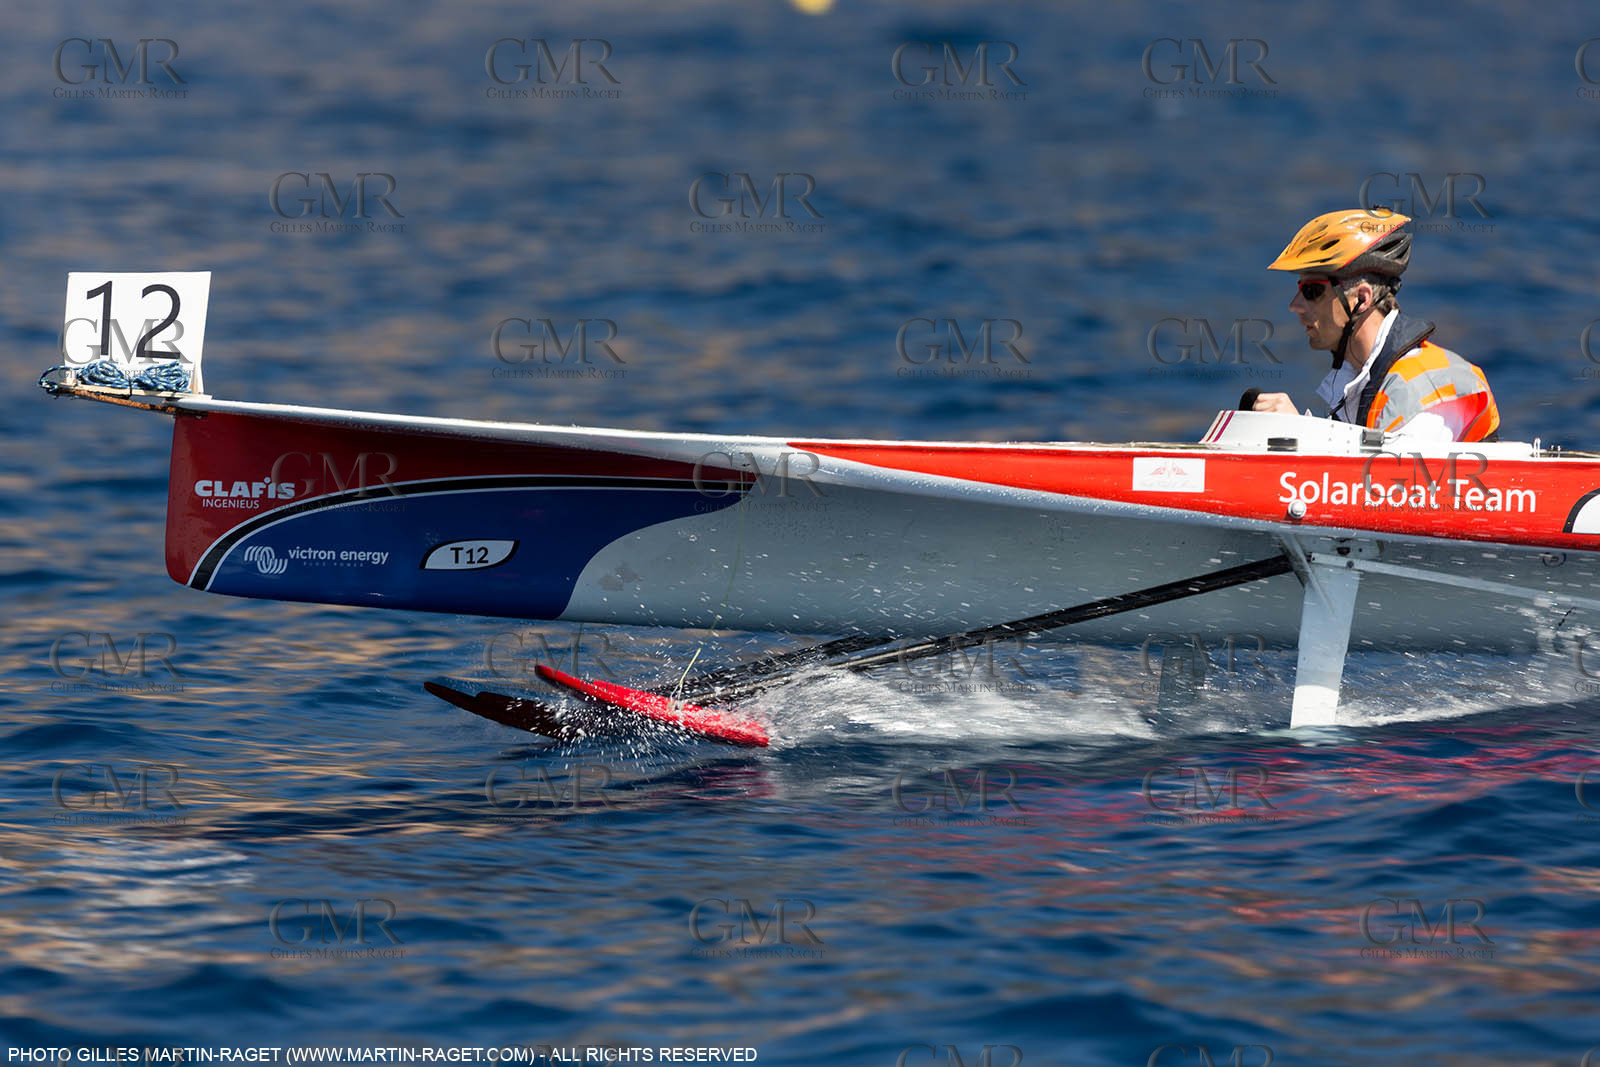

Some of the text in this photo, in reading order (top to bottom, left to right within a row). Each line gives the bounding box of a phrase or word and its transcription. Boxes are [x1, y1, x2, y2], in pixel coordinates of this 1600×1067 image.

[86, 280, 181, 360] 12
[1279, 471, 1536, 513] Solarboat Team
[202, 499, 260, 509] INGENIEUS
[288, 546, 336, 560] victron
[340, 550, 389, 565] energy
[450, 546, 489, 564] T12
